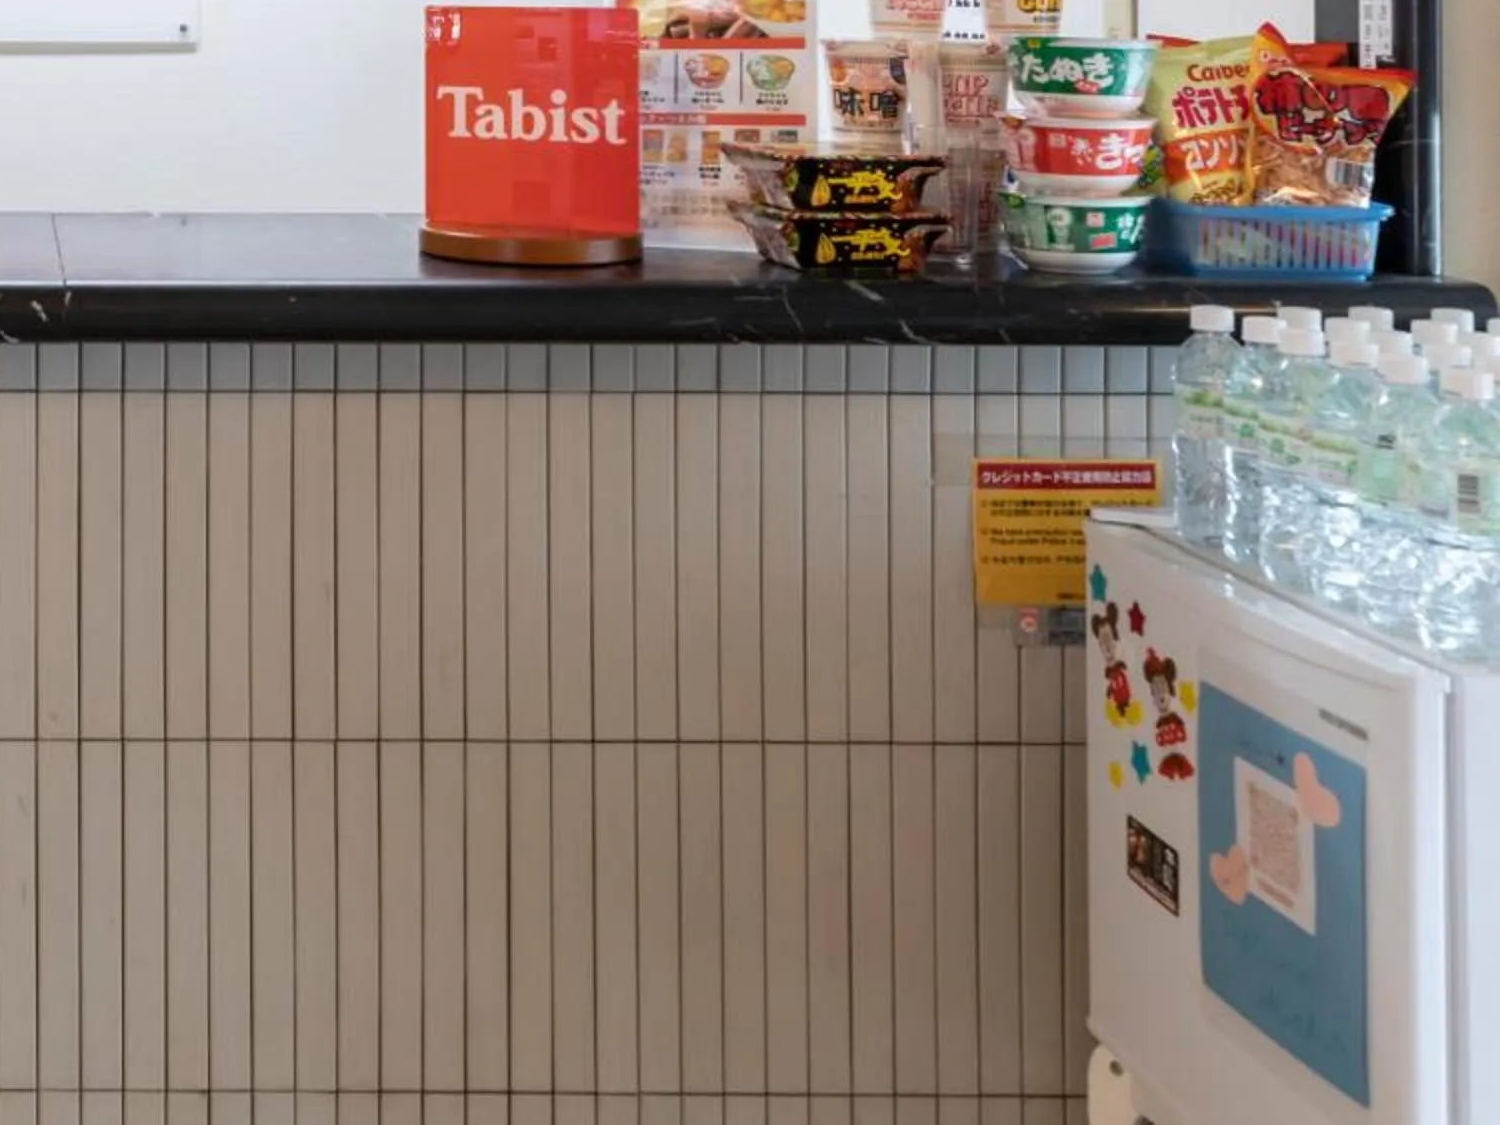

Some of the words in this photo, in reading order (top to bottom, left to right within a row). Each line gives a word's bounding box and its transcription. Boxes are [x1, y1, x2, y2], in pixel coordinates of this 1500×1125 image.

[1021, 52, 1115, 88] たぬき
[436, 85, 628, 145] Tabist
